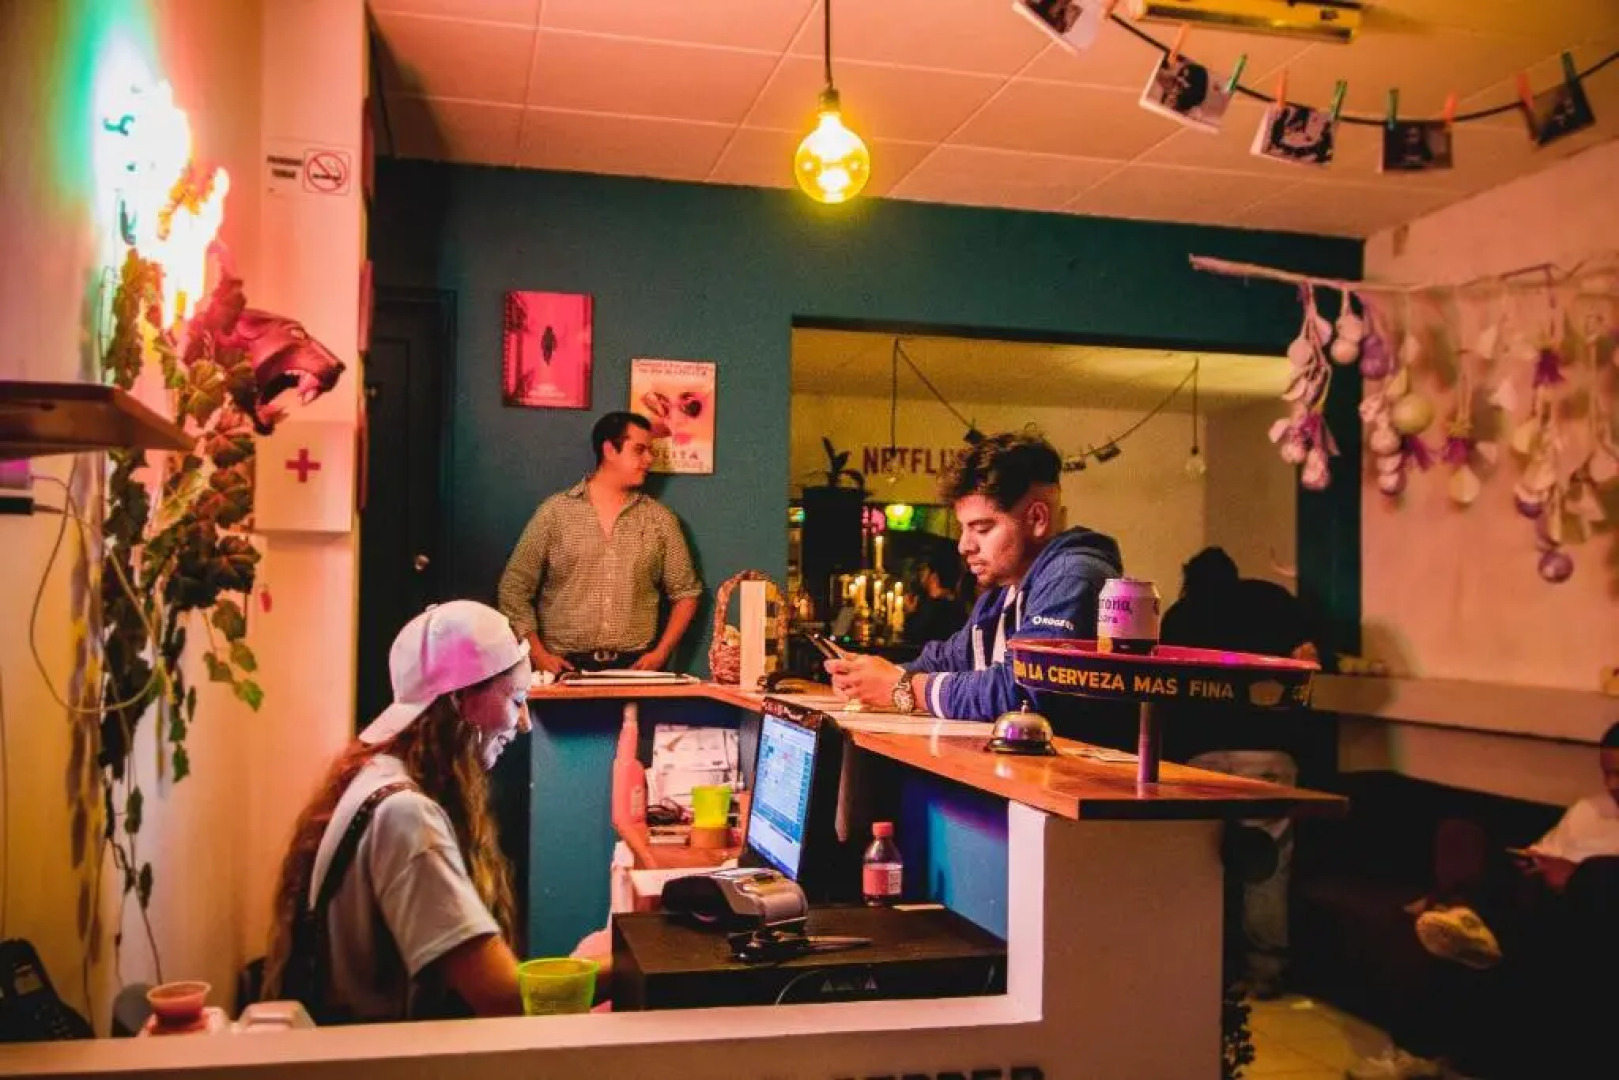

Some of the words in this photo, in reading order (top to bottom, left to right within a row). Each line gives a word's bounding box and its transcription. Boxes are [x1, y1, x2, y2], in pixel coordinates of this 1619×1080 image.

[1028, 662, 1044, 681] LA
[1047, 665, 1125, 691] CERVEZA
[1133, 674, 1178, 696] MAS
[1188, 679, 1235, 699] FINA
